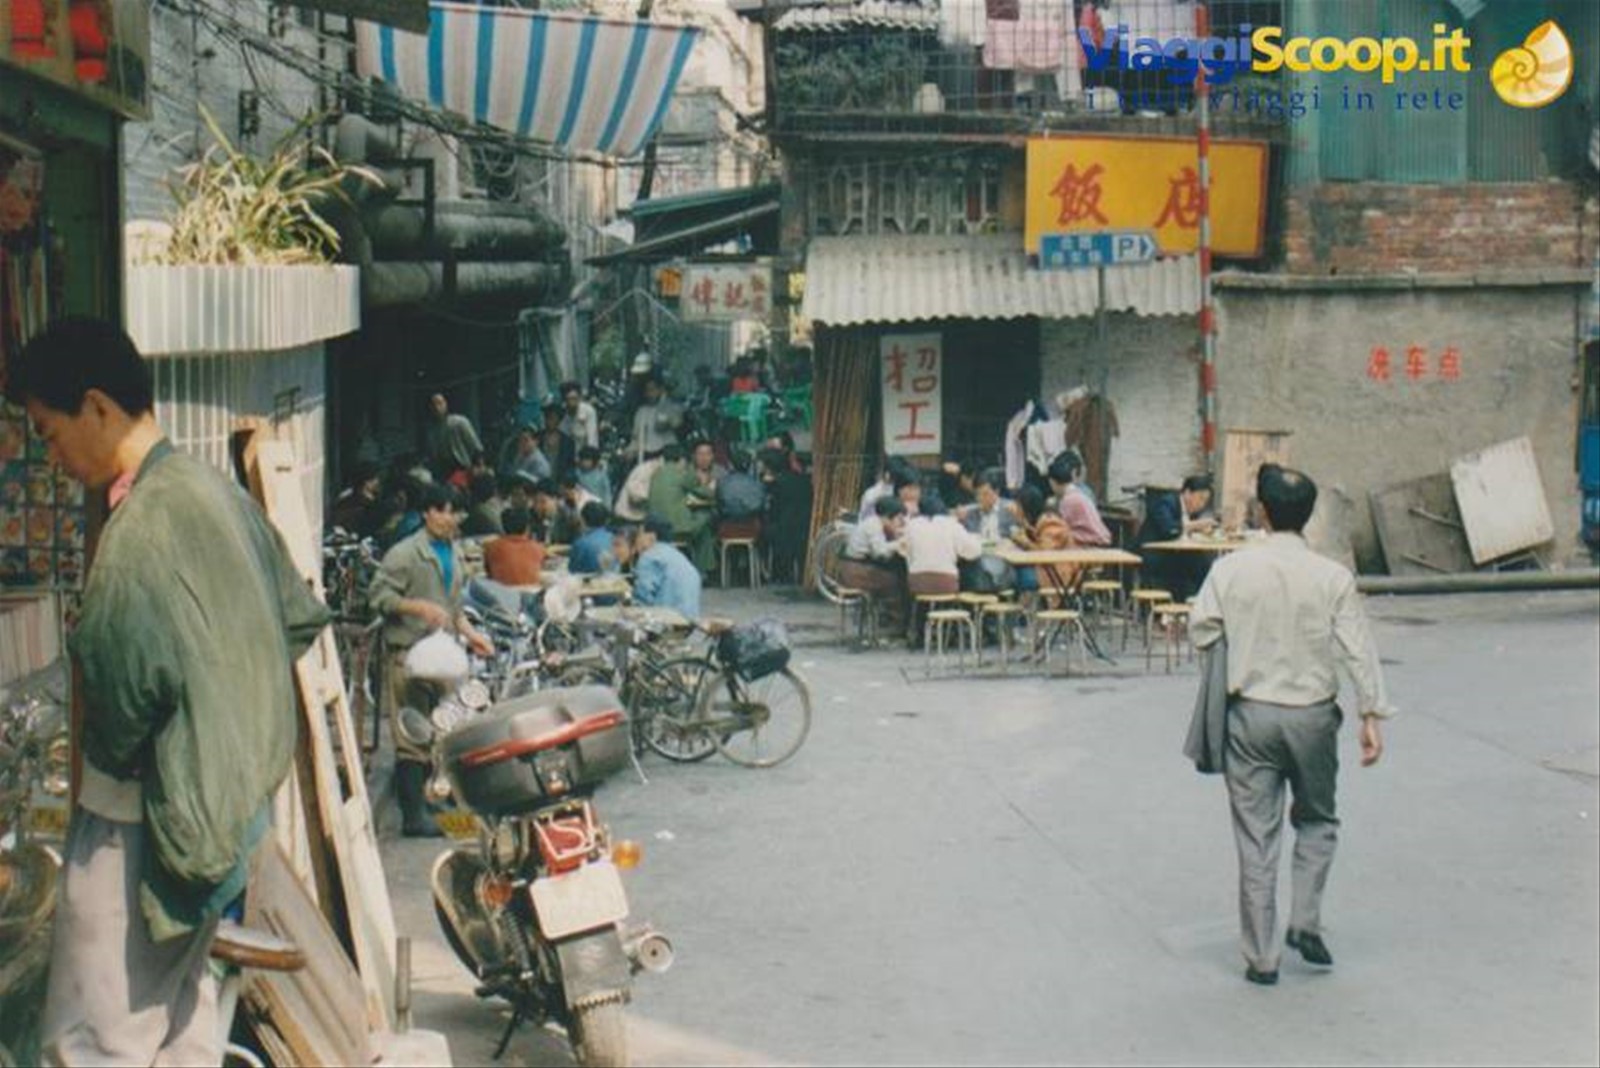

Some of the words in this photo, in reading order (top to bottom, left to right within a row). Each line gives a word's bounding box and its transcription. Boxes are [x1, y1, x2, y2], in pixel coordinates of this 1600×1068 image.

[1118, 237, 1135, 257] P
[1365, 344, 1462, 382] 洗车点
[884, 344, 937, 441] 招工
